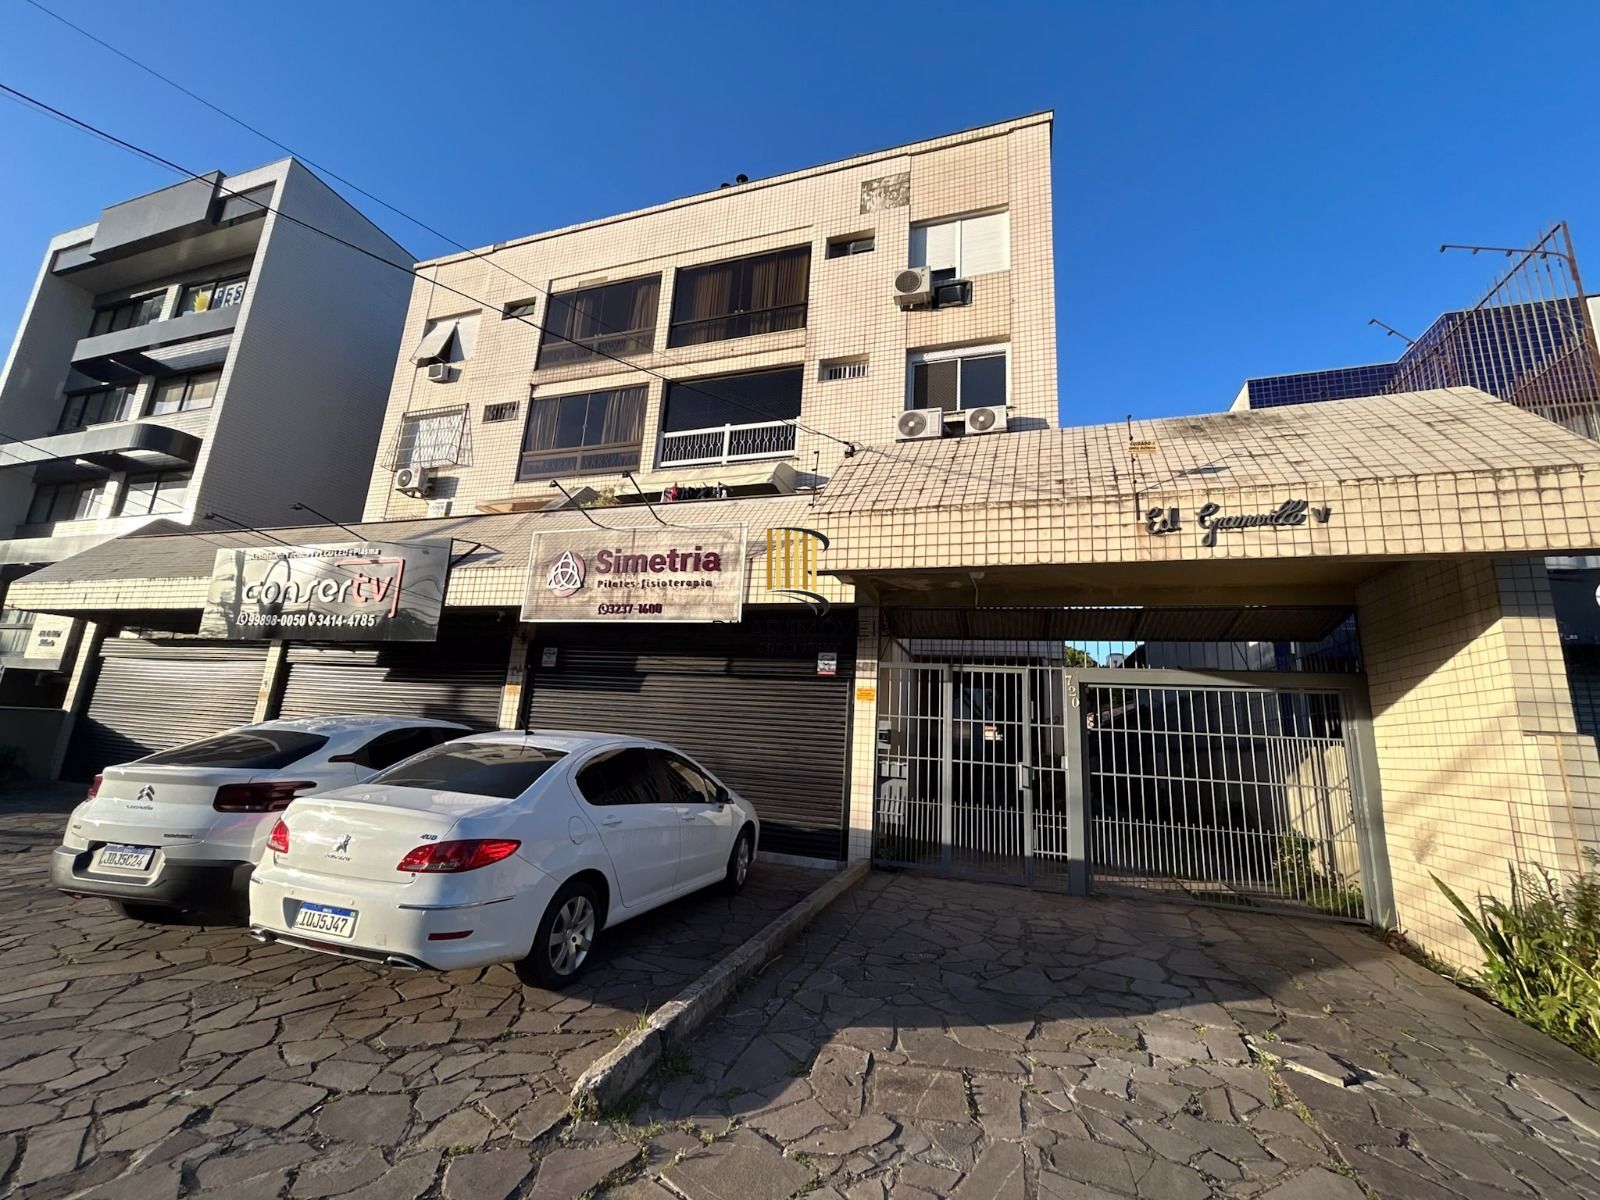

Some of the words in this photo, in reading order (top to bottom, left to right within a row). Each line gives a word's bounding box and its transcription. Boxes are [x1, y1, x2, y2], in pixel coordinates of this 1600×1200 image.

[353, 547, 381, 556] Plasma
[595, 546, 722, 574] Simetria
[247, 614, 306, 627] 99898-0050
[316, 614, 375, 627] 3414-4785
[1065, 674, 1080, 709] 720
[299, 911, 348, 934] IUJ5J47
